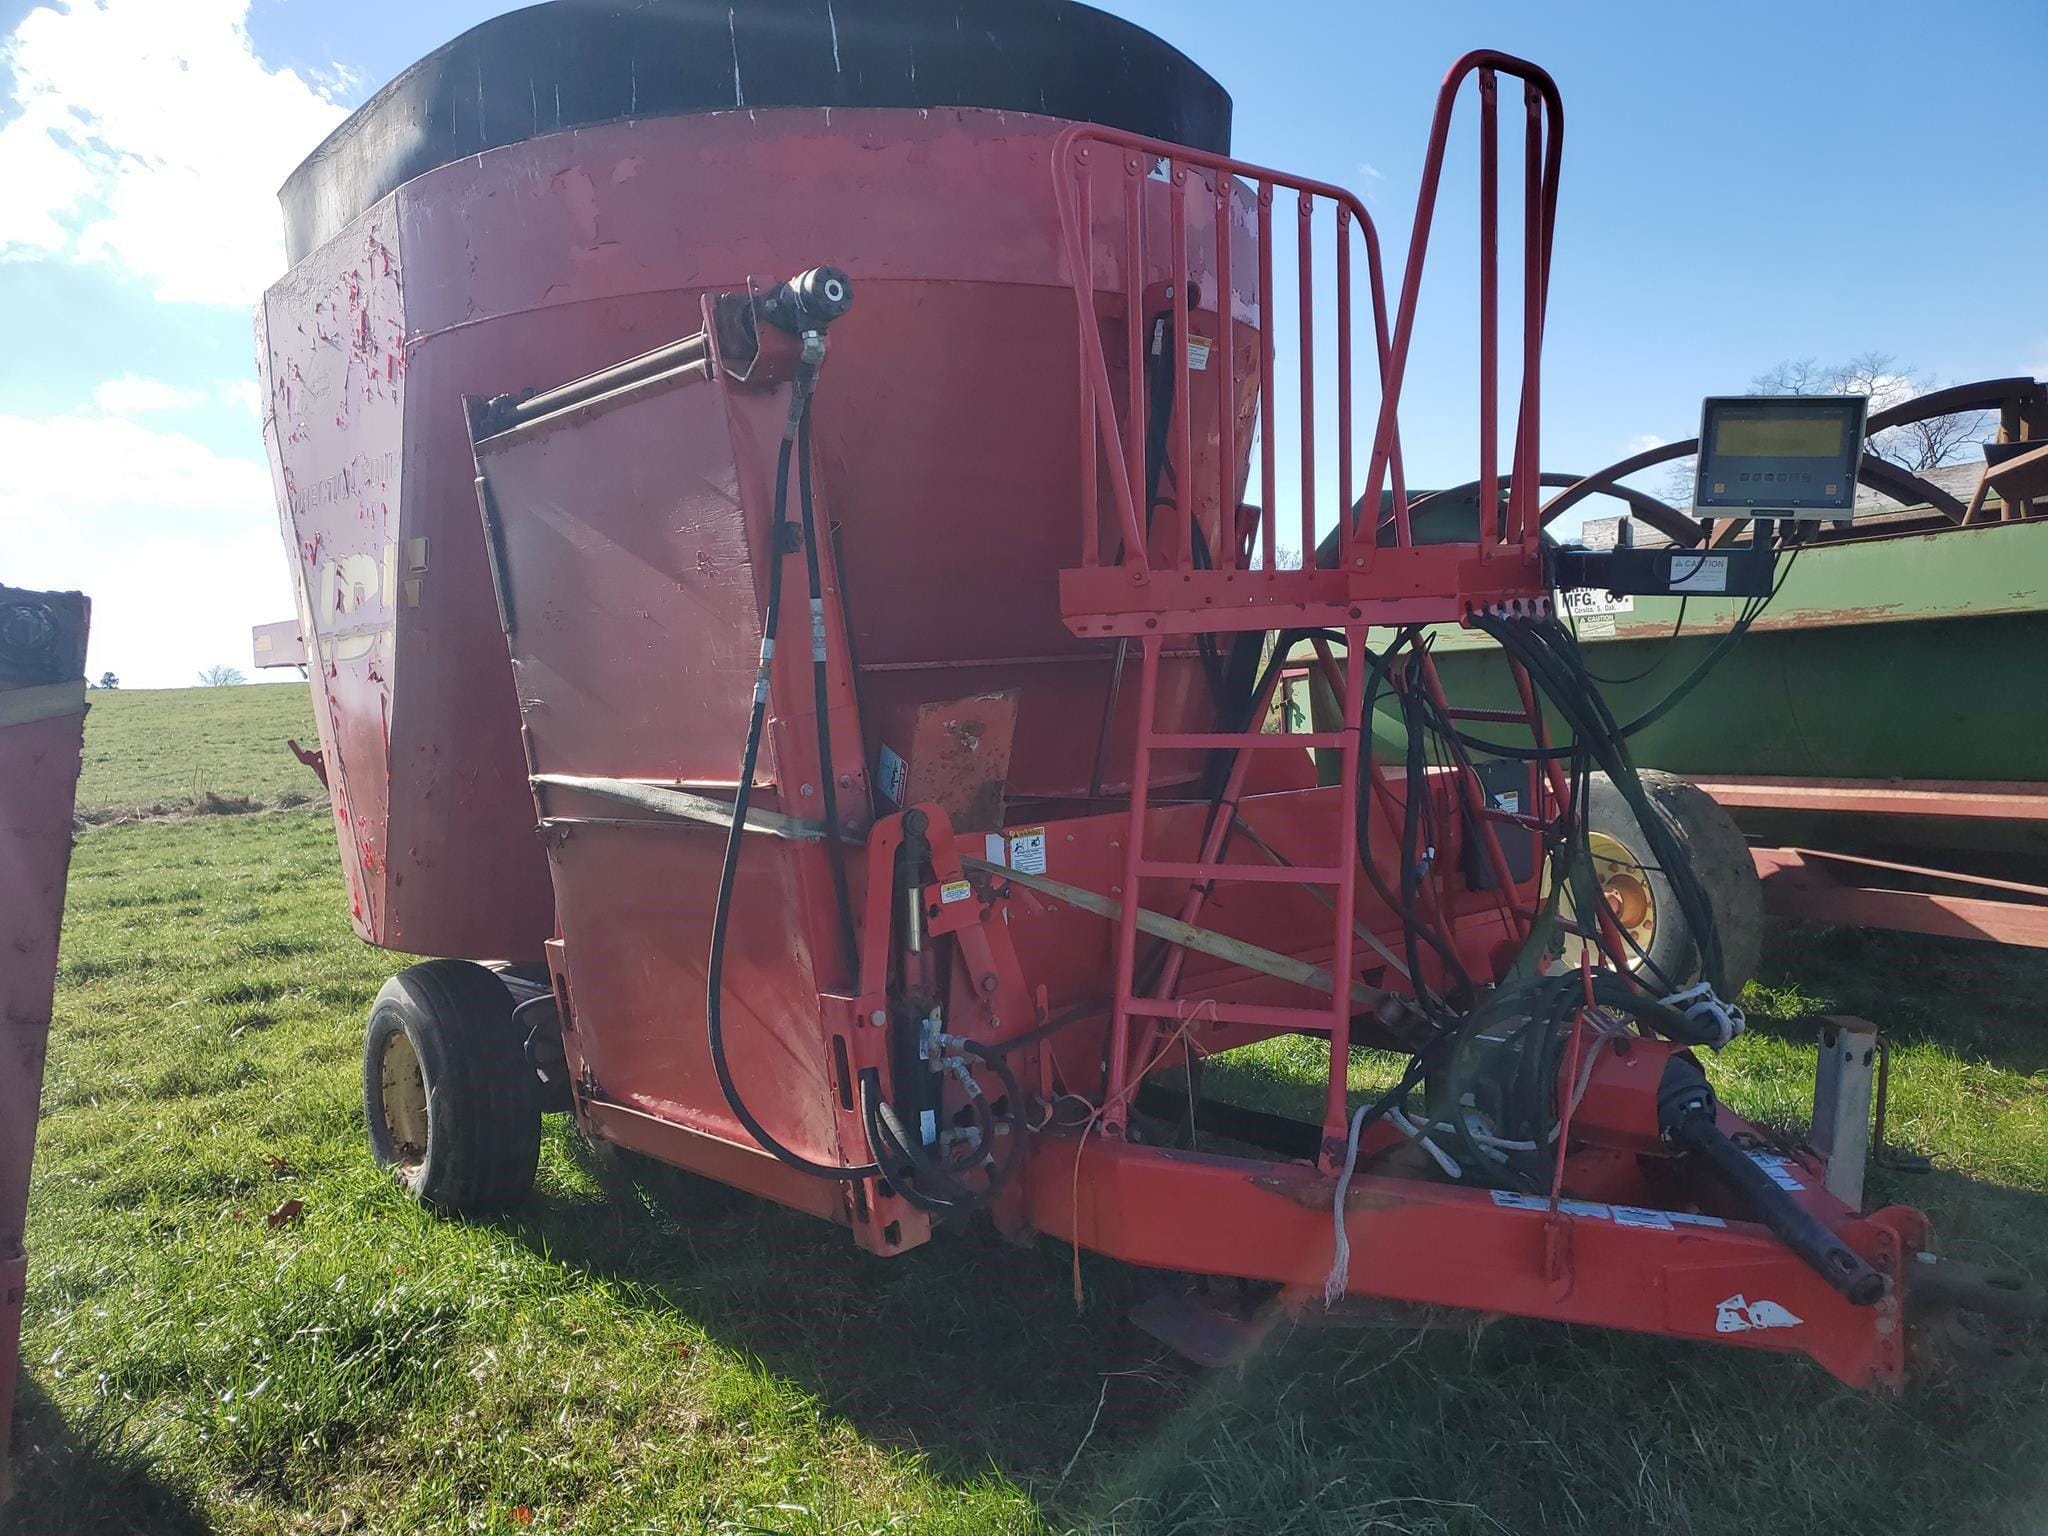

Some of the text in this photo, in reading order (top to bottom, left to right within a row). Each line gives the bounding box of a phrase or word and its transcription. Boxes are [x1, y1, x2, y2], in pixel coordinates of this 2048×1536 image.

[1684, 560, 1724, 568] CATION
[1562, 591, 1596, 608] MFG.
[1587, 614, 1614, 623] CAUTION
